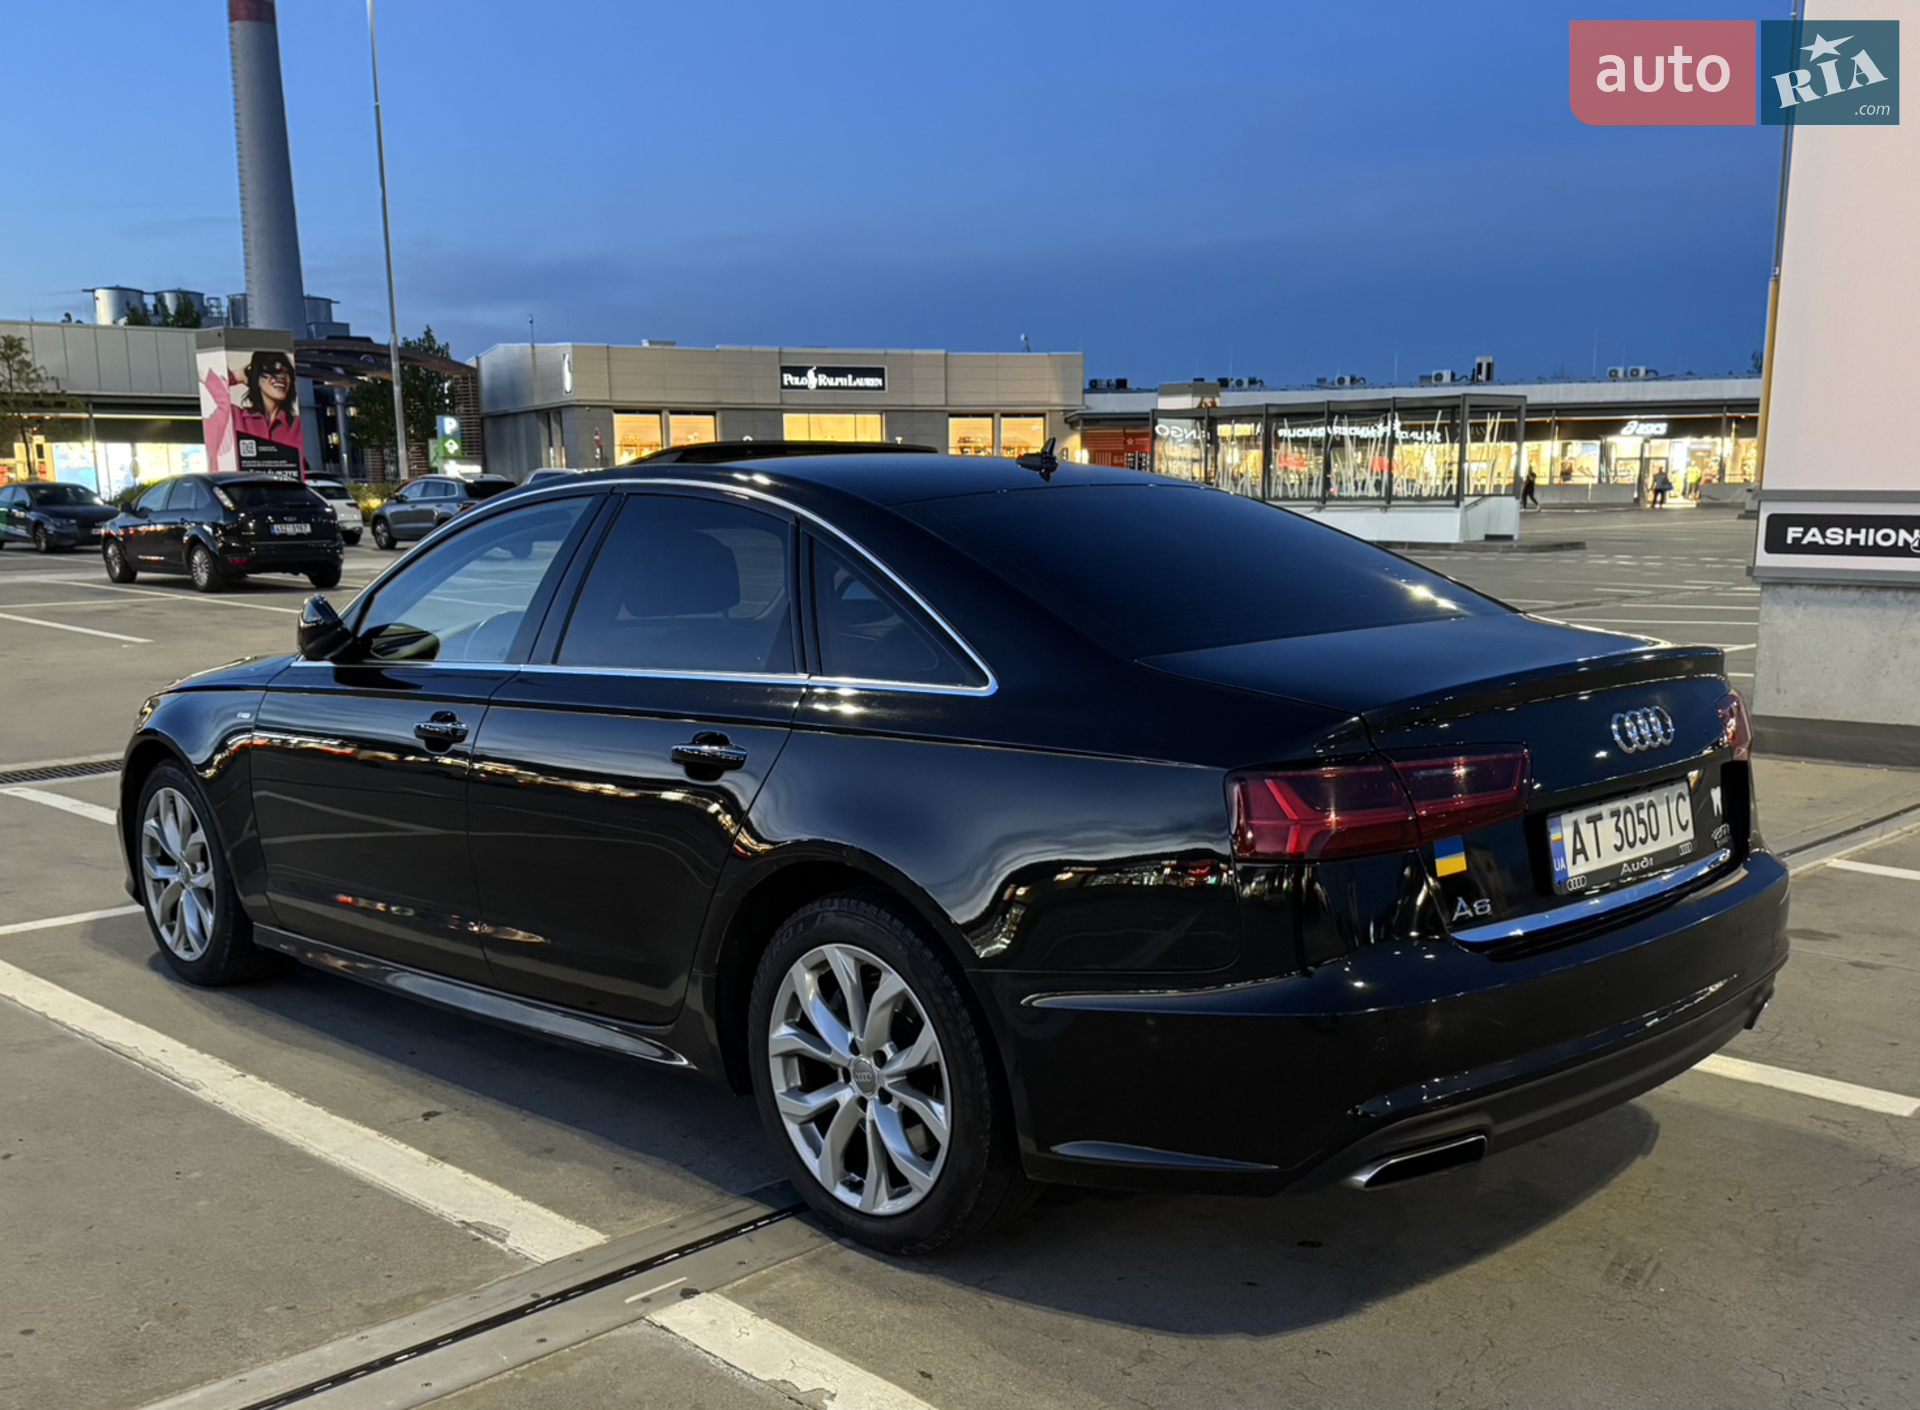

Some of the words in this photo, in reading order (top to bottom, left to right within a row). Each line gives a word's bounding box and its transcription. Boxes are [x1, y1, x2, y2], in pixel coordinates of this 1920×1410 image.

[1786, 527, 1920, 547] FASHION
[1572, 813, 1603, 865] AT
[1610, 799, 1660, 852] 3050
[1665, 791, 1689, 836] IC
[1554, 857, 1567, 871] UA
[1620, 856, 1653, 875] Audi
[1451, 896, 1491, 921] A6
